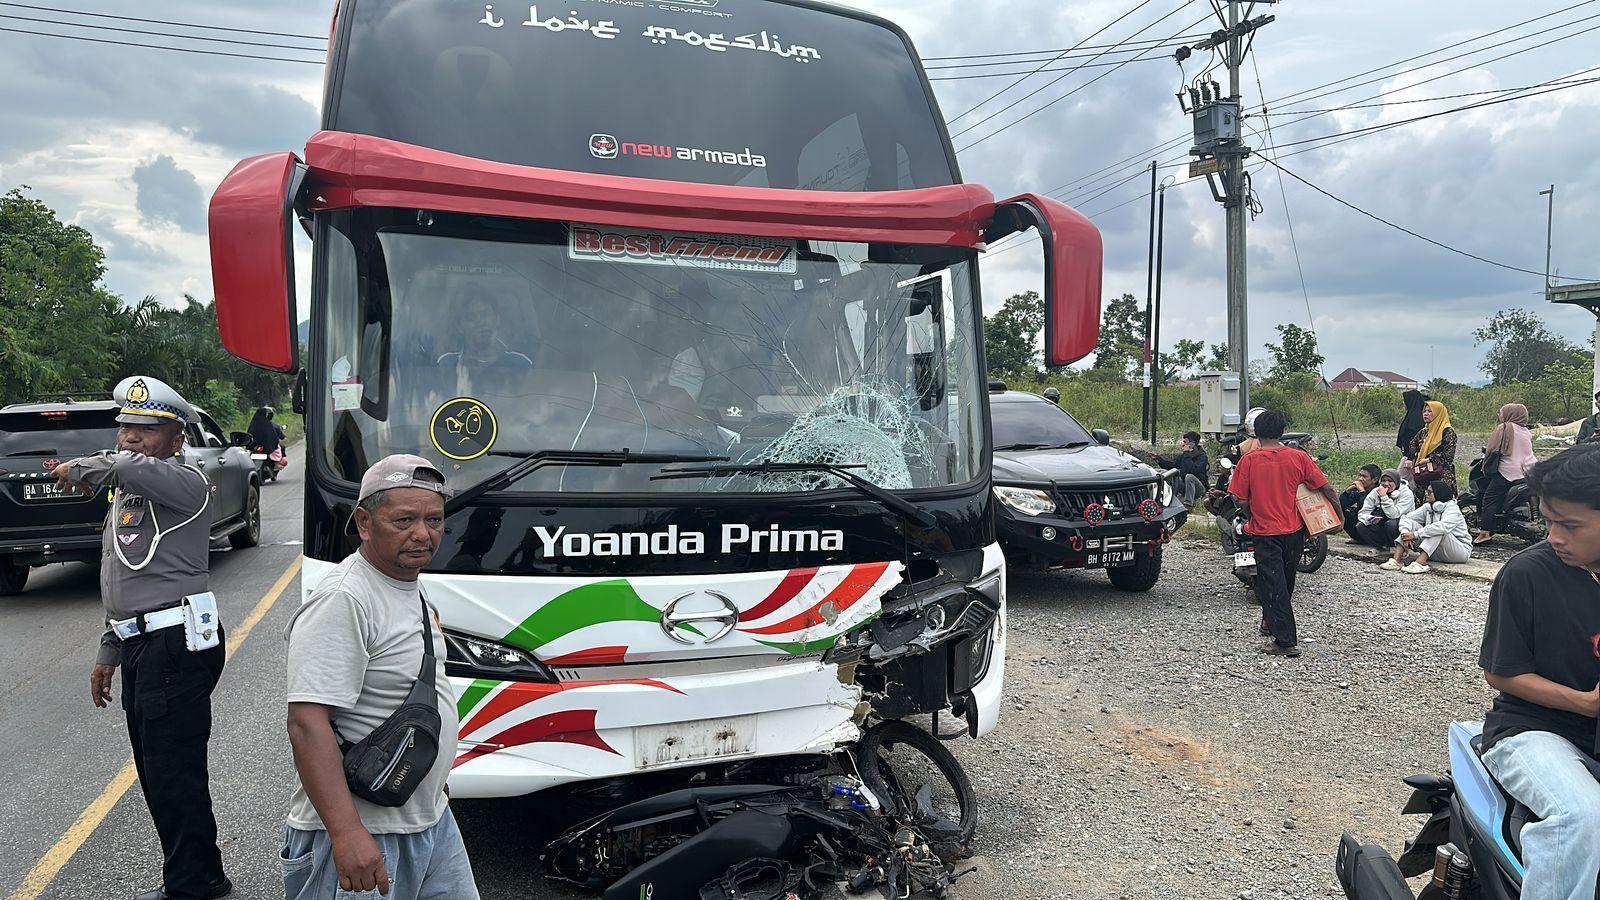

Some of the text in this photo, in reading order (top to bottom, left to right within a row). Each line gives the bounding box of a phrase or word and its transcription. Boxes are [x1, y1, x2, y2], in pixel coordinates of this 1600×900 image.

[658, 4, 734, 18] COMFORT
[621, 142, 767, 168] new armada
[25, 485, 37, 495] BA
[42, 484, 62, 493] 164
[532, 523, 844, 558] Yoanda Prima
[1087, 554, 1098, 565] BH
[1102, 551, 1121, 563] 8172
[1122, 550, 1135, 561] MM
